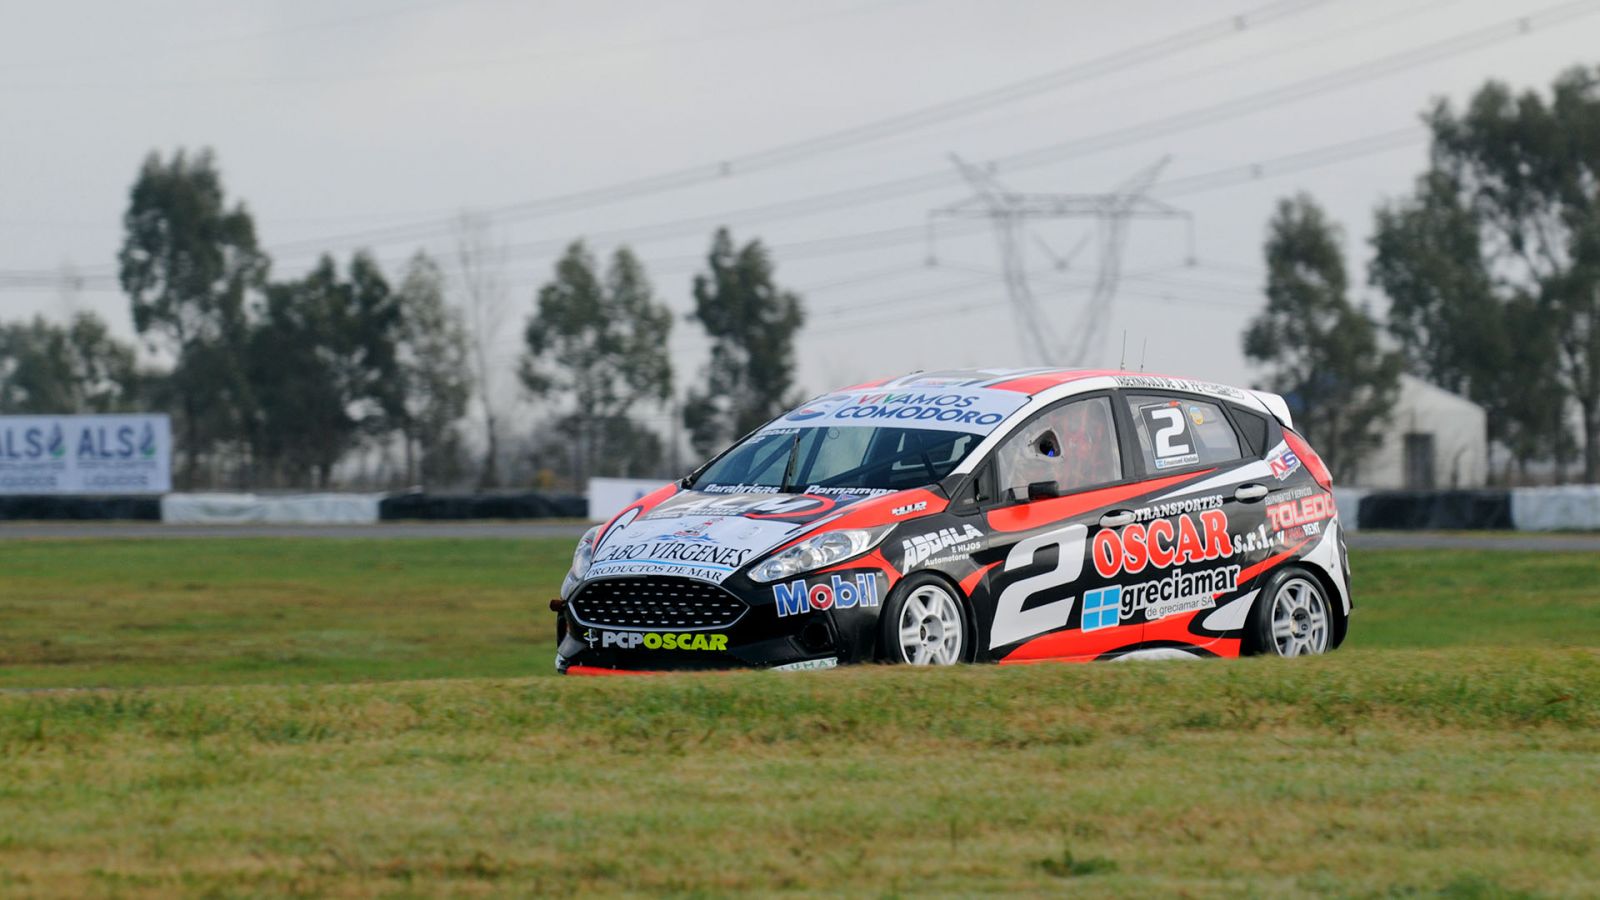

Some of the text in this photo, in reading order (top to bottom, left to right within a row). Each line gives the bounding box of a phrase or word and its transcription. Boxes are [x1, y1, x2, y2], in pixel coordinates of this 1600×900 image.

[835, 405, 1003, 425] COMODORO
[857, 393, 980, 408] VIVAMOS
[0, 427, 42, 458] LS
[77, 425, 134, 458] ALS
[1151, 407, 1190, 458] 2
[1134, 495, 1223, 522] TRANSPORTES
[1265, 493, 1336, 532] TOLEDO
[593, 544, 648, 562] CABO
[902, 523, 984, 575] ABDALA
[958, 541, 981, 553] HIJOS
[1093, 509, 1233, 578] OSCAR
[587, 564, 723, 582] PRODUCTOS DE MAR
[924, 553, 970, 567] Automotores
[772, 572, 880, 618] Mobil
[989, 524, 1088, 650] 2
[1121, 566, 1240, 617] greciamar
[1146, 596, 1214, 618] de greciamar SA
